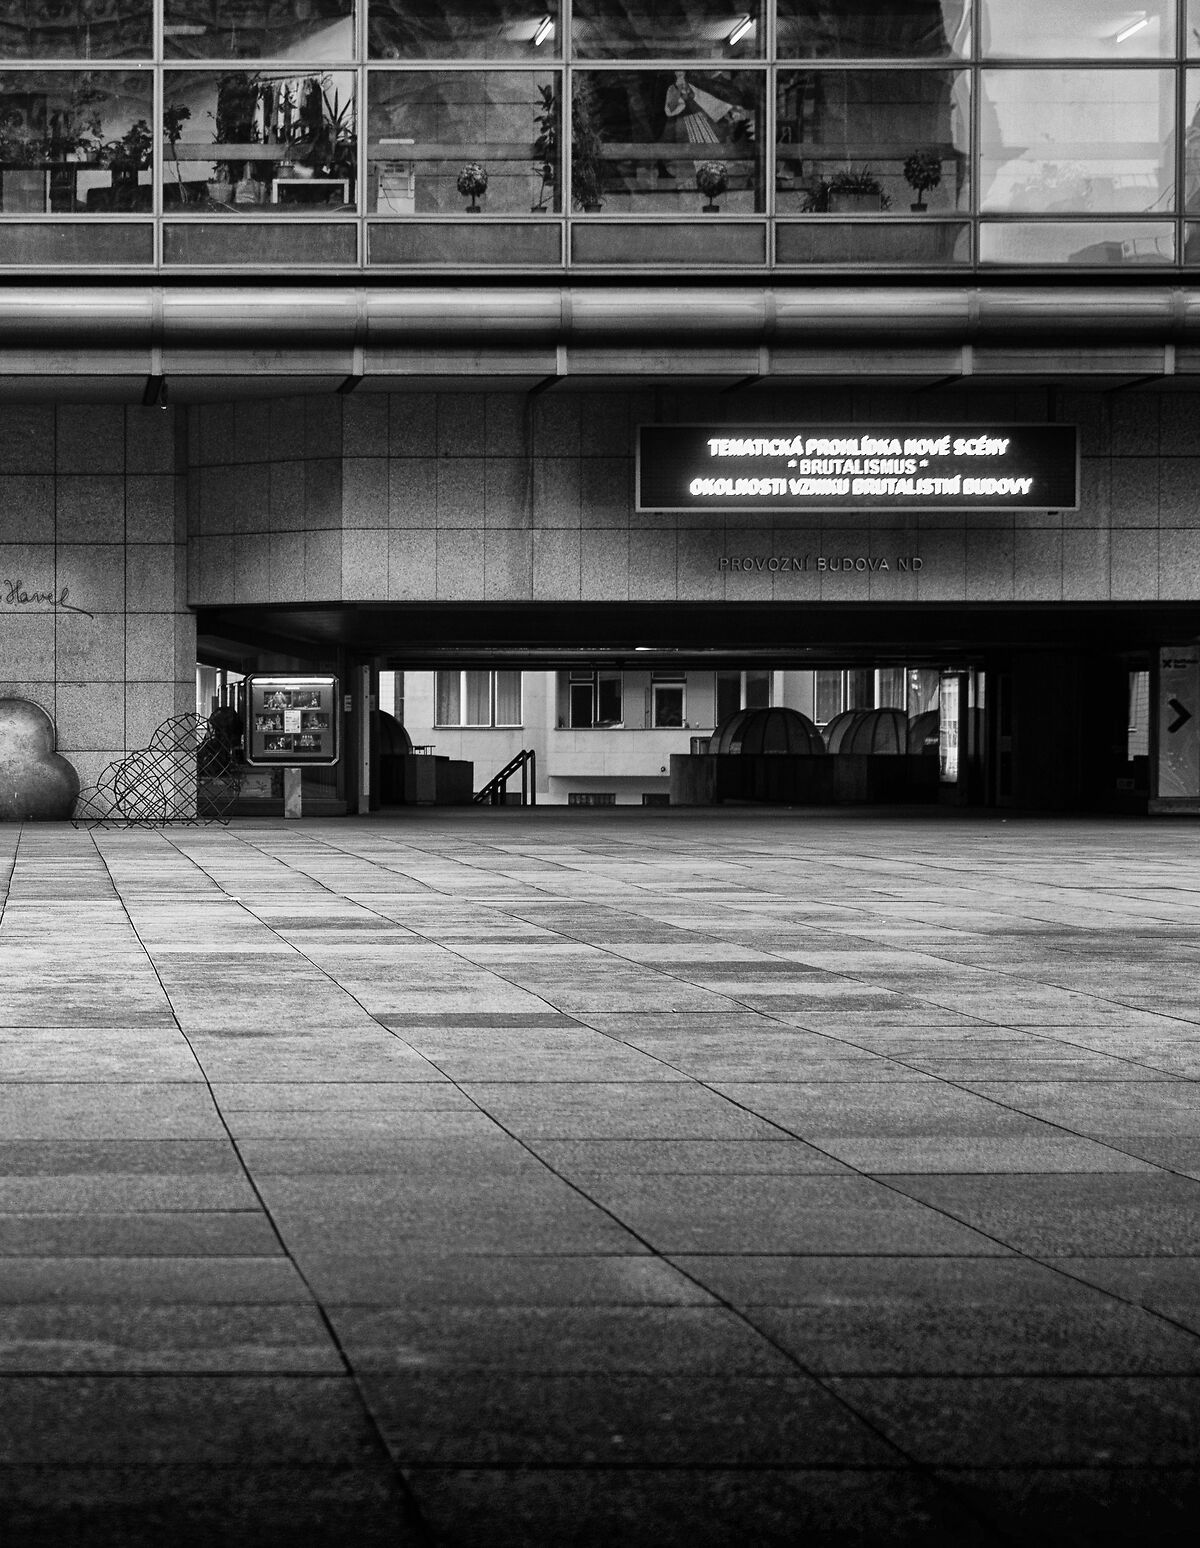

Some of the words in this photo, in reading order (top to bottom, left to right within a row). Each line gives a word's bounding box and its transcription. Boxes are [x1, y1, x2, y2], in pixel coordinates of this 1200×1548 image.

[707, 435, 804, 456] TEMATICKÁ
[805, 435, 902, 456] PROHLÍDKA
[904, 435, 950, 456] NOVÉ
[953, 435, 1009, 456] SCÉNY
[689, 478, 787, 495] OKOLNOSTI
[962, 478, 1032, 495] BUDOVY
[719, 553, 809, 571] PROVOZNÍ
[817, 558, 889, 571] BUDOVA
